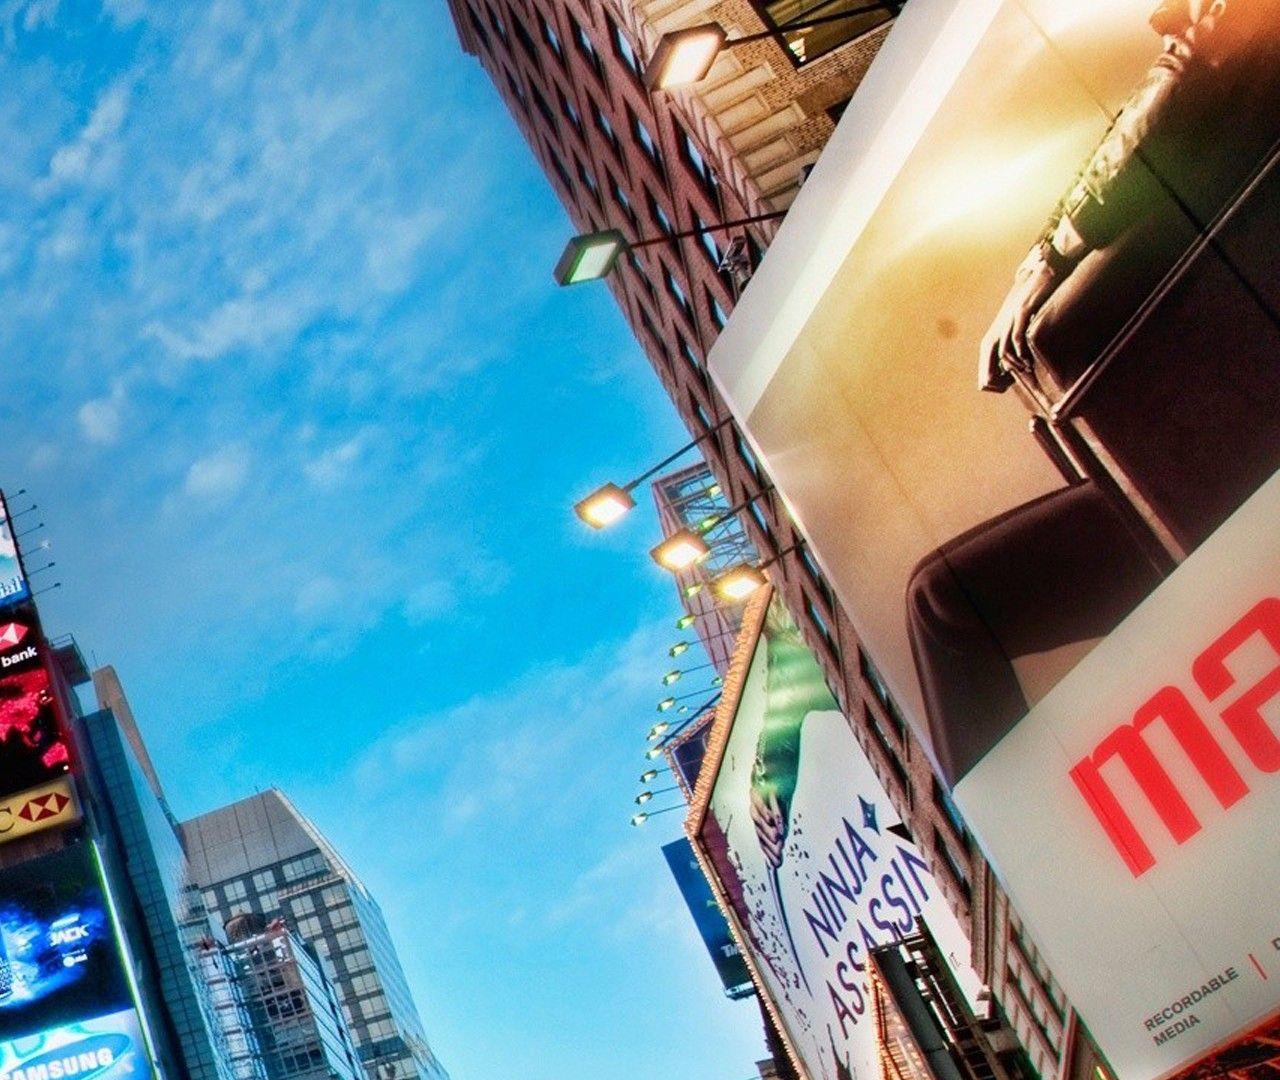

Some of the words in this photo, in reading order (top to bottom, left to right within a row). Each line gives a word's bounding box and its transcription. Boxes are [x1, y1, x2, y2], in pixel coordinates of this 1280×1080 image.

[1, 645, 38, 668] bank
[802, 816, 877, 958] NINJA
[1144, 967, 1239, 1031] RECORDABLE
[1153, 1014, 1201, 1046] MEDIA
